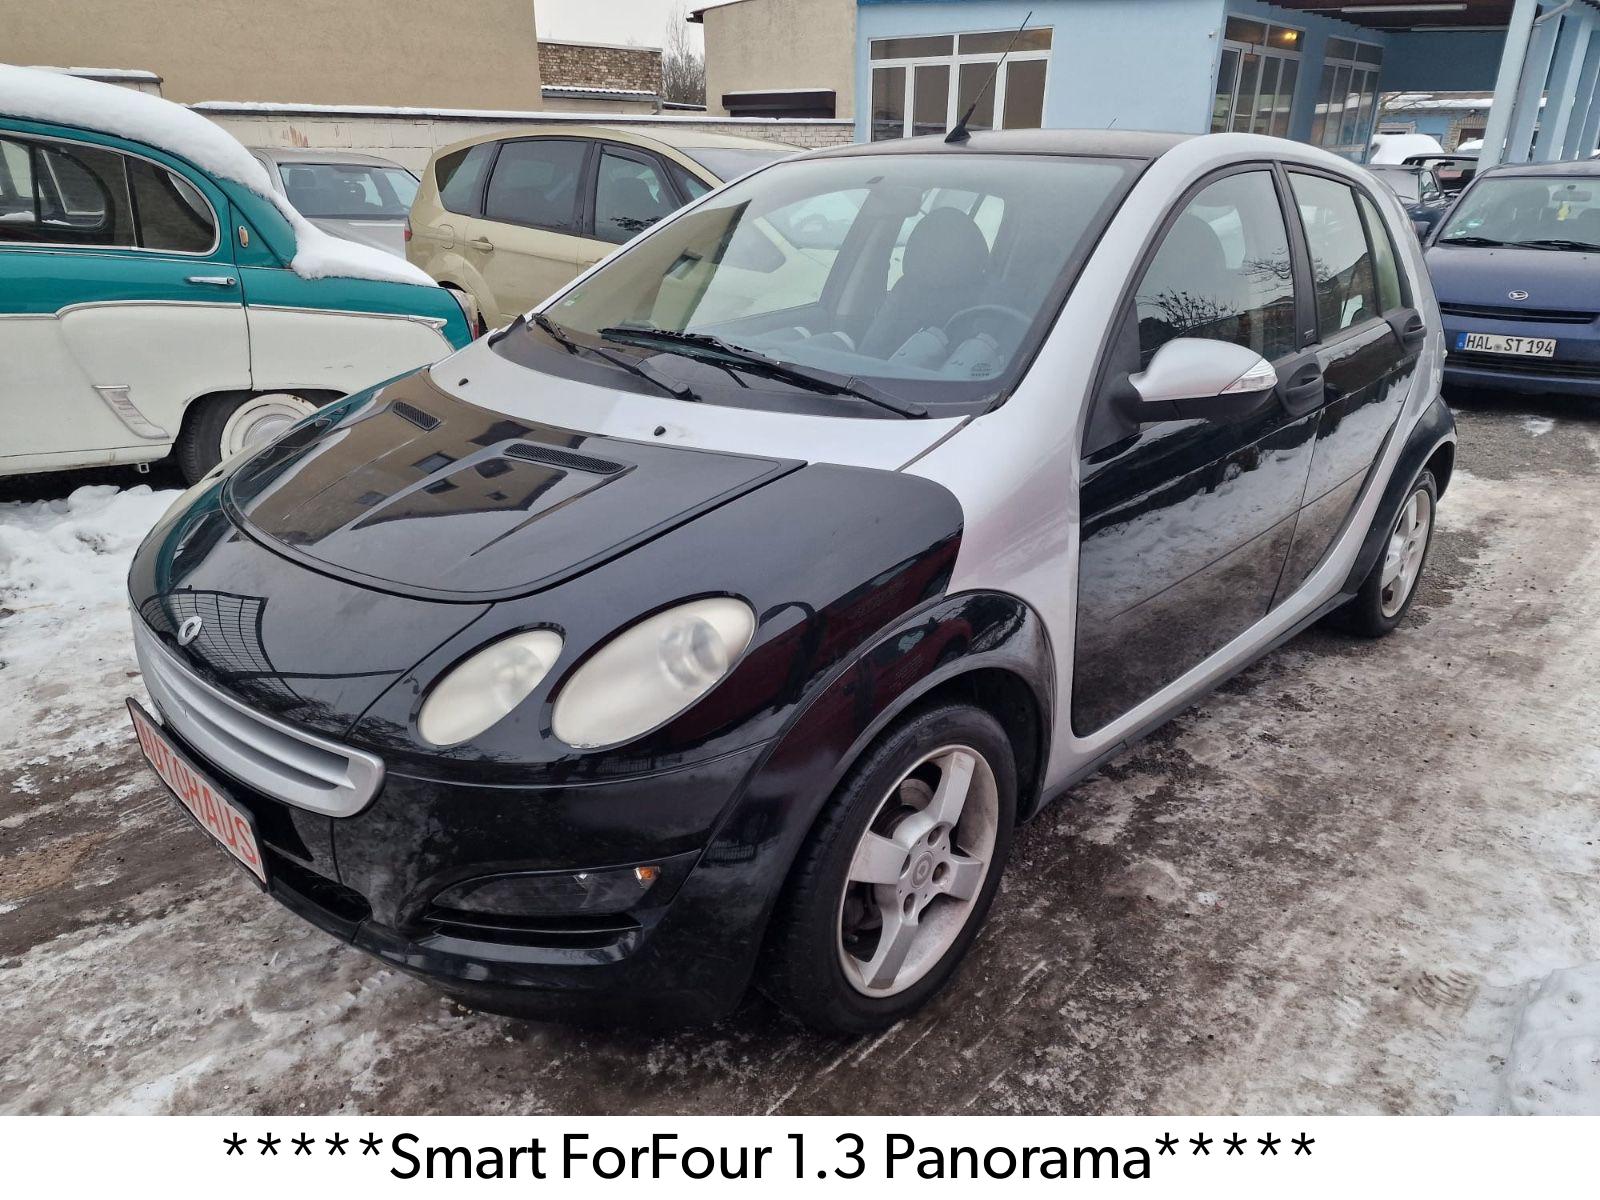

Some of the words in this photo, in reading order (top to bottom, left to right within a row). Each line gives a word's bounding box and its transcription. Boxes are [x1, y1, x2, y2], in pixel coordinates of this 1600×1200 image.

[1466, 335, 1493, 350] HAL
[1504, 338, 1526, 352] ST
[1526, 340, 1553, 354] 194
[137, 717, 258, 866] AUTOHAUS
